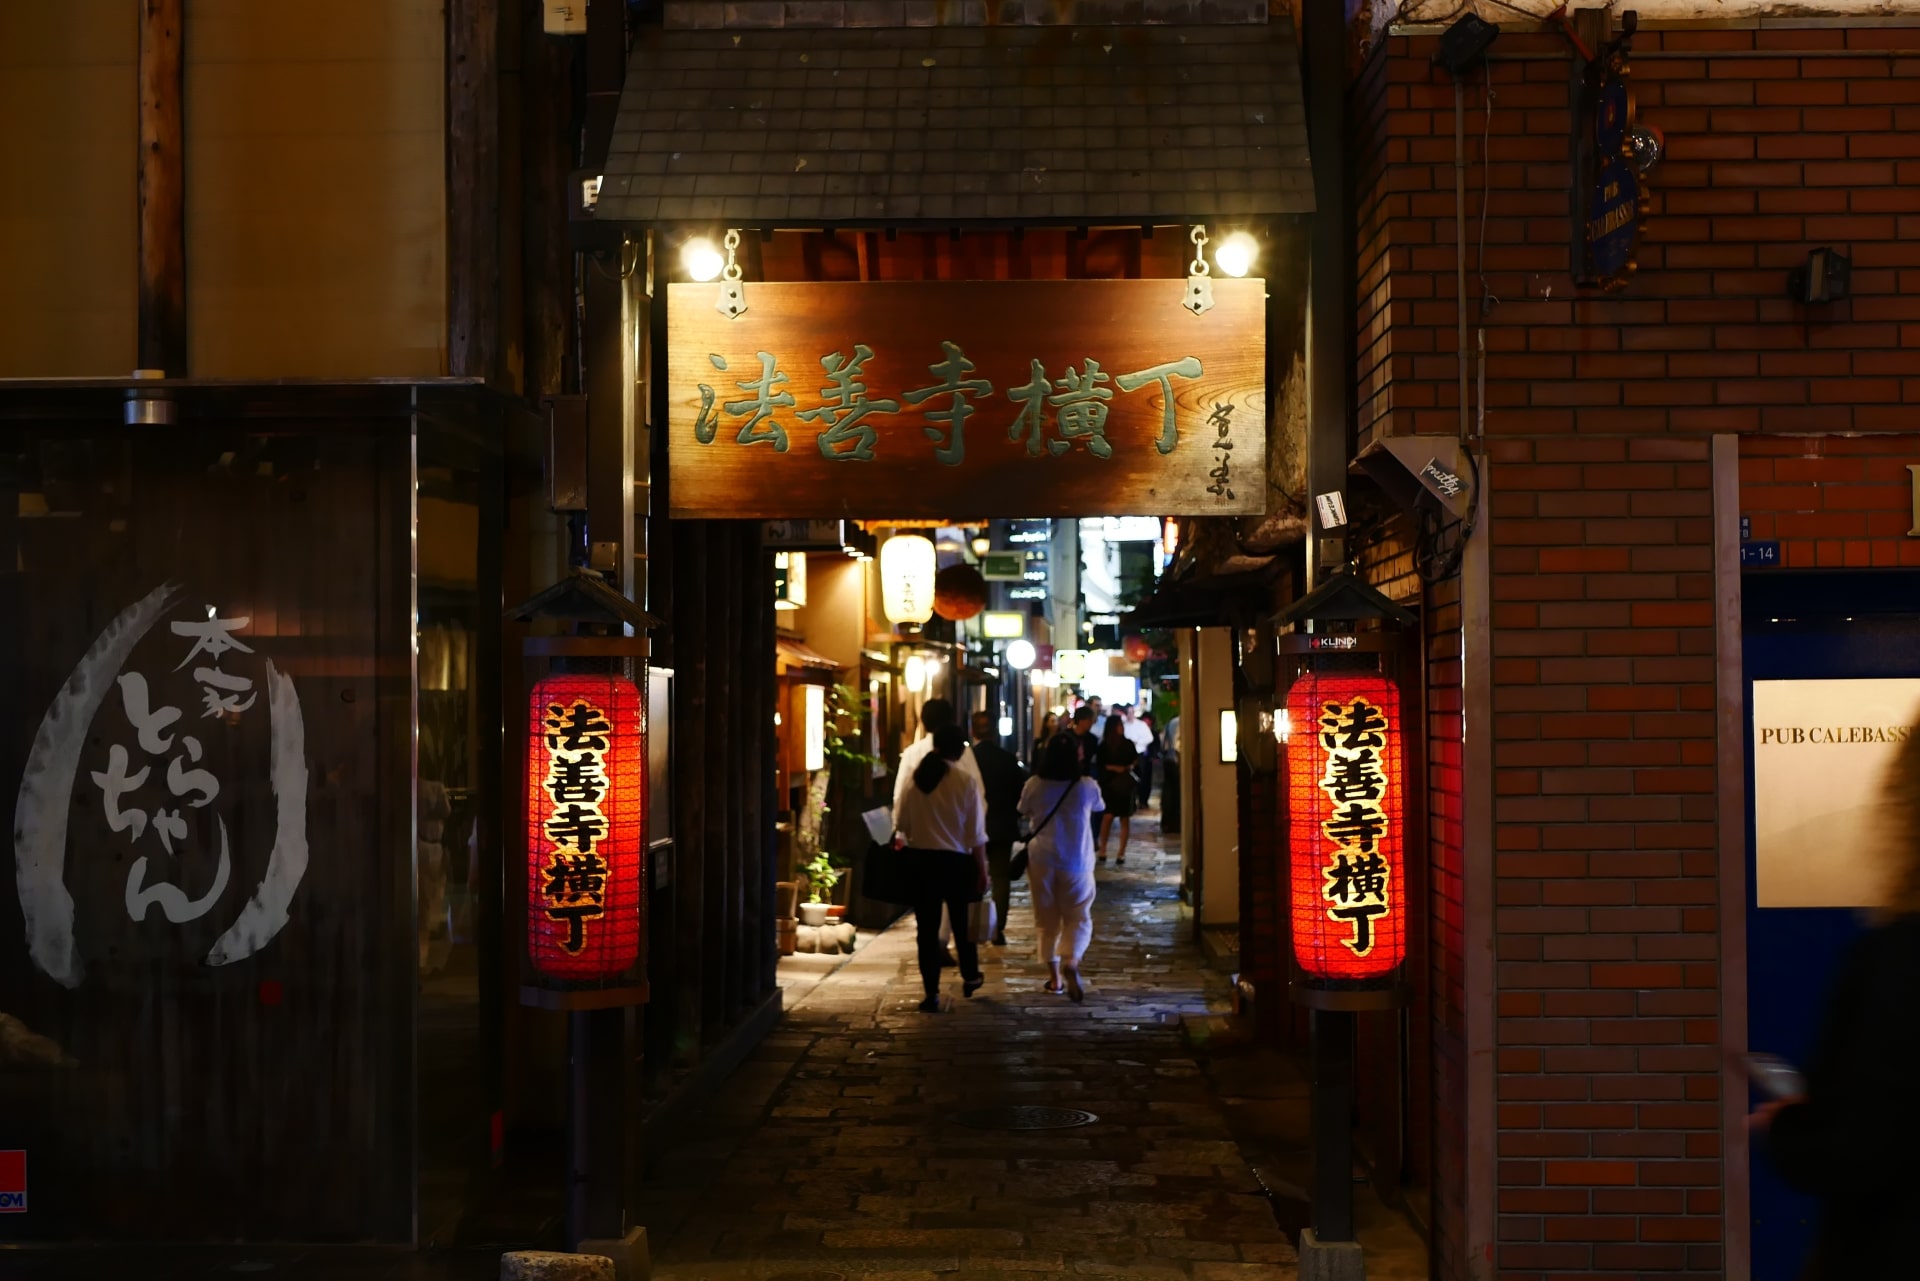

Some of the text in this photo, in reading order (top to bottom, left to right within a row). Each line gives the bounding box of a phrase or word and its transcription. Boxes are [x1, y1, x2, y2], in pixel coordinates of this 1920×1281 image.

[693, 340, 1204, 467] 法善寺横丁
[170, 604, 257, 718] 本家
[1760, 726, 1913, 744] PUB CALEBASS
[545, 701, 611, 955] 法善寺横丁
[1320, 699, 1388, 955] 法善寺横丁
